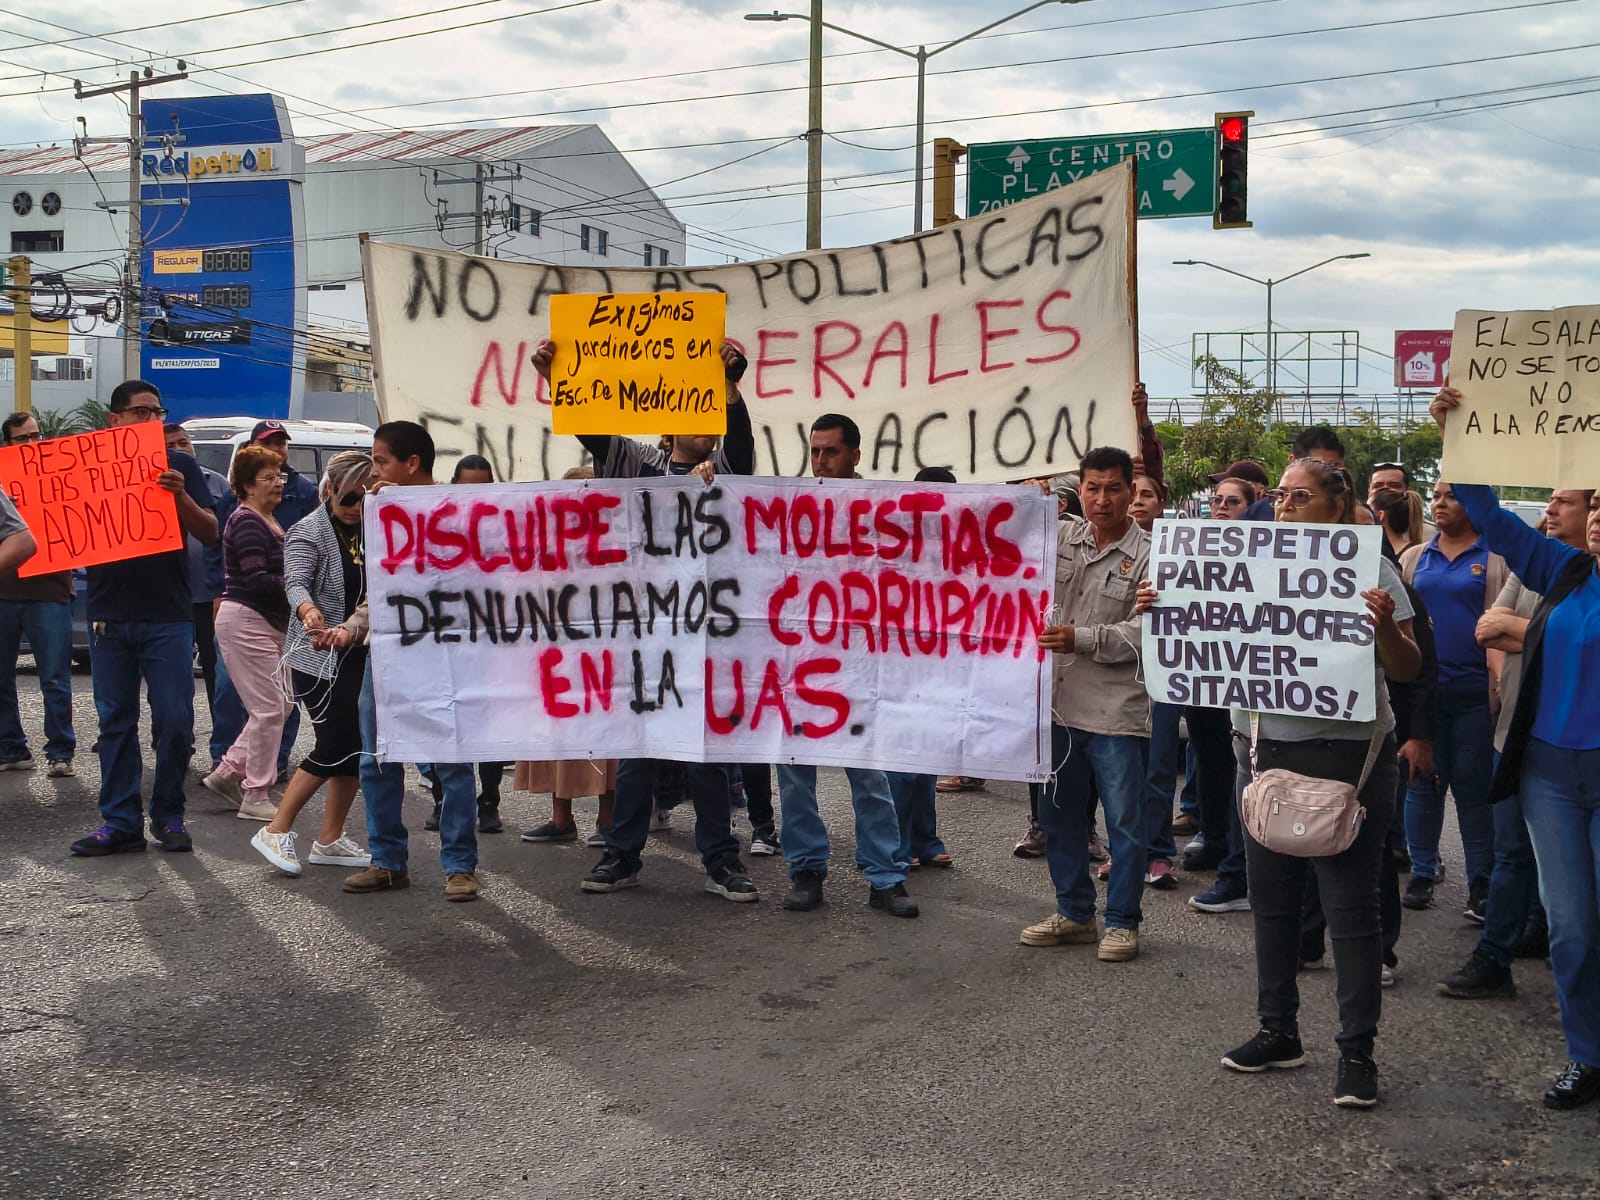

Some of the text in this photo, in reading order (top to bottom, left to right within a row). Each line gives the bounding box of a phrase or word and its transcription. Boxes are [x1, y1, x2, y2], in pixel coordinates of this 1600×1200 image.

[1049, 140, 1173, 166] CENTRO
[157, 257, 199, 266] REGULAR
[405, 252, 500, 322] NO
[751, 197, 1104, 308] POLITICAS
[589, 294, 694, 336] Exigimos
[1475, 316, 1517, 348] EL
[687, 338, 712, 360] en
[1469, 357, 1507, 381] NO
[1516, 356, 1556, 375] SE
[592, 379, 613, 401] De
[1529, 381, 1572, 407] NO
[1466, 410, 1482, 435] A
[1493, 413, 1521, 436] LA
[19, 427, 140, 477] RESPETO
[9, 451, 166, 507] A LAS PLAZAS
[378, 487, 1037, 579] DISCULPE LAS MOLESTIAS.
[1158, 526, 1359, 561] ¡RESPETO
[1156, 560, 1357, 600] PARA LOS
[386, 578, 740, 647] DENUNCIAMOS
[1157, 638, 1318, 676] UNIVER-
[538, 647, 615, 718] EN
[629, 649, 684, 714] LA
[1166, 672, 1359, 721] SITARIOS!
